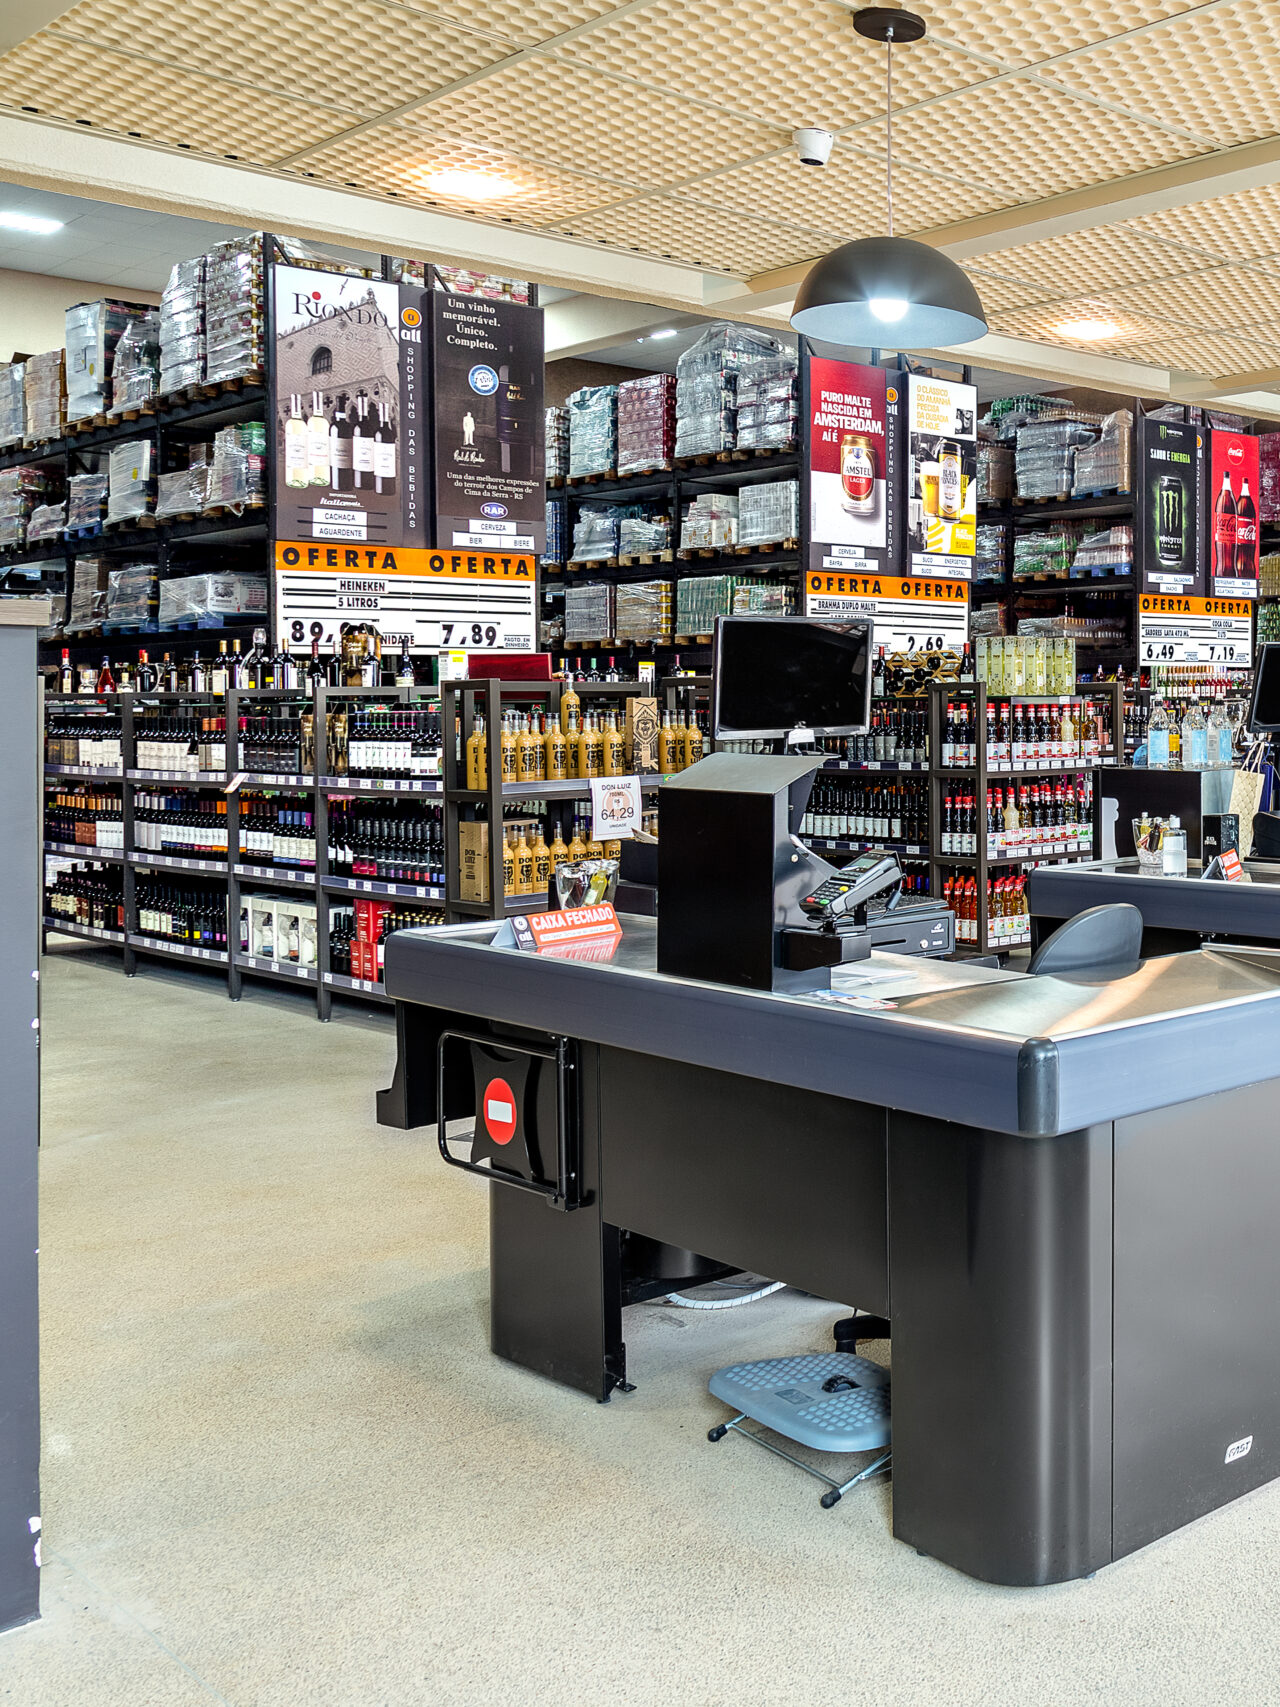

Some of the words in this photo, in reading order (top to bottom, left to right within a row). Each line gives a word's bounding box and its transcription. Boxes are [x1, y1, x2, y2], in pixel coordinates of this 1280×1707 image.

[447, 298, 465, 309] Um
[468, 302, 496, 314] vinho
[442, 311, 501, 327] memorável.
[456, 321, 489, 337] Único.
[446, 334, 498, 351] Completo.
[406, 347, 416, 419] SHOPPING
[916, 384, 922, 393] O
[921, 385, 949, 397] CLÁSSICO
[916, 393, 925, 402] DO
[820, 390, 844, 404] PURO
[844, 394, 872, 408] MALTE
[821, 401, 859, 417] NASCIDA
[859, 407, 873, 419] EM
[916, 402, 940, 412] PRECISA
[813, 411, 885, 437] AMSTERDAM,
[916, 411, 925, 419] DA
[925, 412, 949, 423] OUSADIA
[916, 420, 925, 428] DE
[408, 429, 416, 456] DAS
[822, 429, 832, 442] AÍ
[832, 429, 839, 443] É
[1166, 450, 1171, 461] E
[1170, 451, 1191, 464] ENERGIA
[846, 466, 871, 477] AMSTEL
[446, 471, 463, 480] Uma
[463, 473, 475, 481] das
[476, 475, 506, 484] melhores
[506, 478, 540, 488] expressões
[464, 481, 485, 489] terroir
[486, 483, 498, 491] dos
[498, 484, 524, 493] Campos
[524, 486, 533, 494] de
[464, 488, 481, 497] Cima
[482, 489, 491, 497] da
[491, 490, 509, 499] Serra
[408, 465, 416, 528] BEBIDAS
[324, 512, 356, 522] CACHAÇA
[483, 505, 506, 516] RAR
[319, 527, 363, 537] AGUARDENTE
[480, 523, 507, 532] CERVEZA
[469, 537, 483, 545] BIER
[282, 547, 398, 570] OFERTA
[429, 554, 530, 577] OFERTA
[339, 580, 386, 592] HEINEKEN
[810, 576, 882, 594] OFERTA
[900, 581, 964, 599] OFERTA
[338, 597, 344, 607] 5
[346, 597, 379, 608] LITROS
[818, 600, 841, 610] BRAHMA
[841, 601, 860, 611] DUPLO
[860, 602, 877, 612] MALTE
[1142, 598, 1191, 612] OFERTA
[1205, 601, 1249, 615] OFERTA
[441, 623, 497, 647] 7,89
[1146, 644, 1174, 659] 6,49
[1209, 646, 1235, 661] 7,19
[616, 782, 632, 790] LUIZ
[601, 806, 635, 821] 64,29
[531, 914, 565, 931] CAIXA
[564, 906, 614, 926] FECHADO
